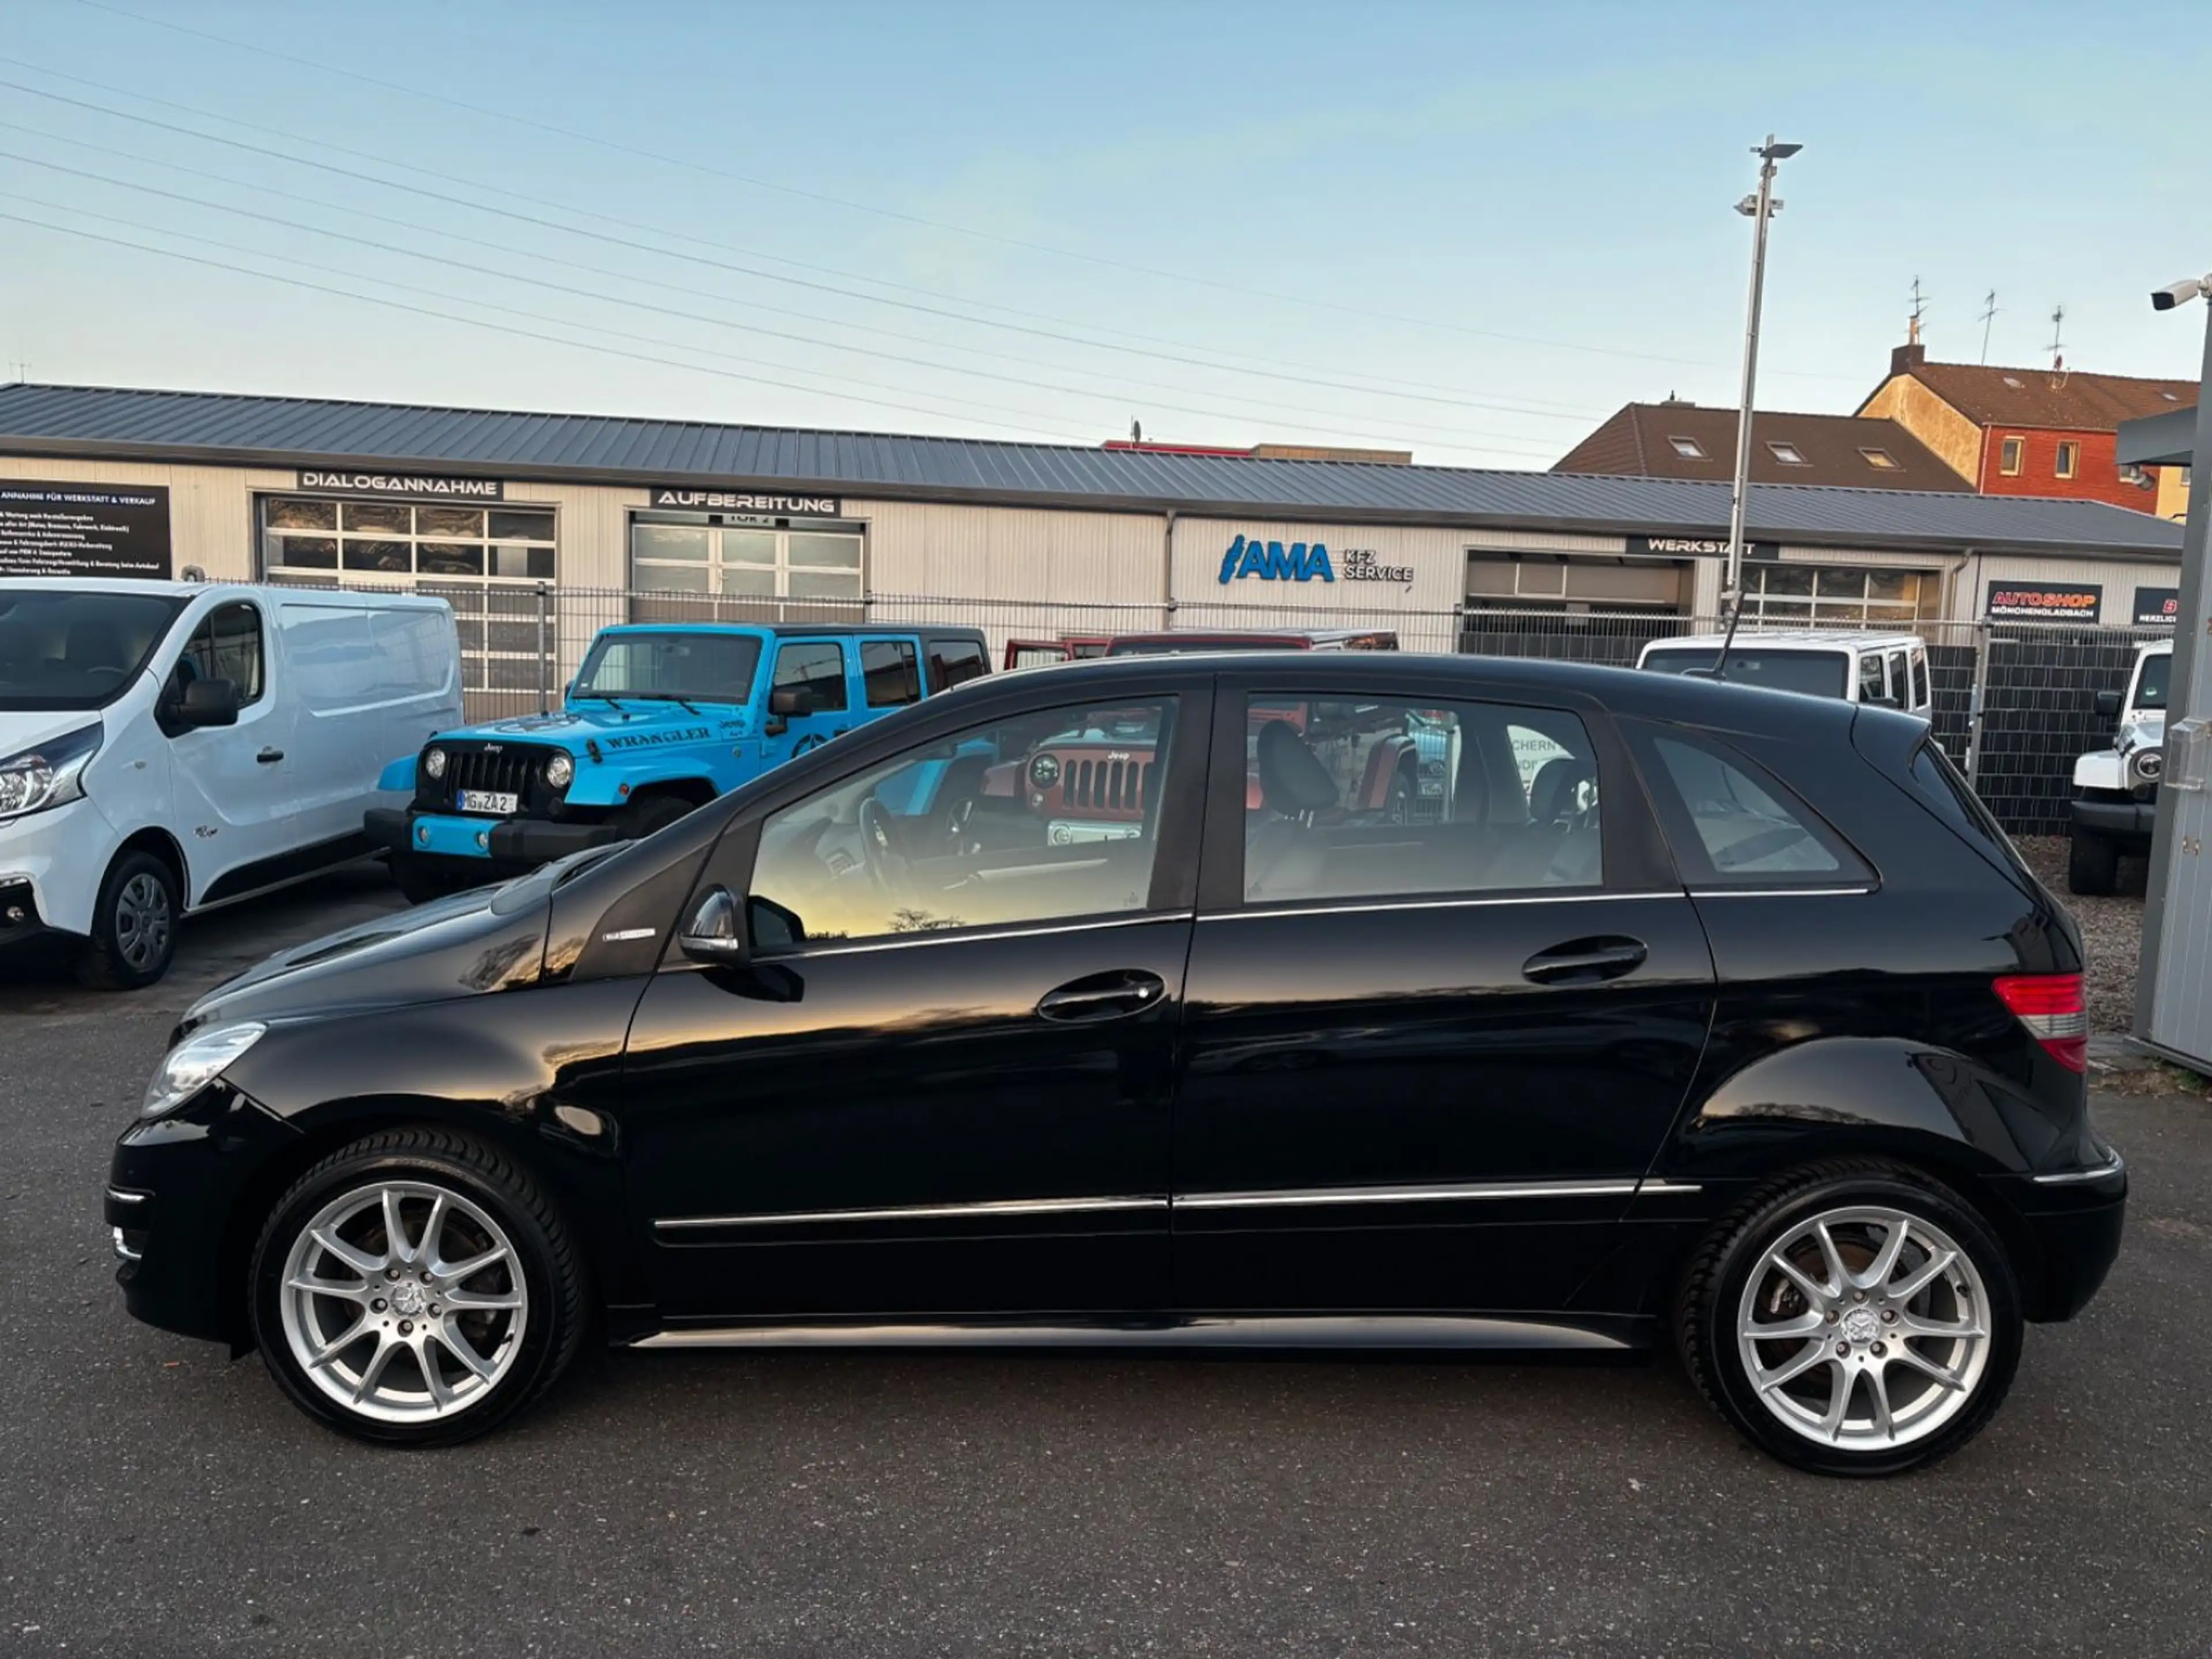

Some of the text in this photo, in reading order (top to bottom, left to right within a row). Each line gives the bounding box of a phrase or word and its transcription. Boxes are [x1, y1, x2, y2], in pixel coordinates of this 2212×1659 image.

[303, 472, 498, 495] DIALOGANNAHME
[47, 491, 62, 501] FÜR
[64, 494, 109, 503] WERKSTATT
[112, 496, 117, 504] &
[119, 497, 156, 506] VERKAUF
[658, 491, 835, 513] AUFBEREITUNG
[1236, 540, 1335, 583] AMA
[1344, 549, 1376, 565] KFZ
[1344, 565, 1414, 581] SERVICE
[1992, 591, 2097, 608] AUTOSHOP
[1991, 605, 2094, 618] MÖNCHENGLADBACH
[607, 727, 710, 749] WRANGLER
[1107, 751, 1130, 760] Jeep
